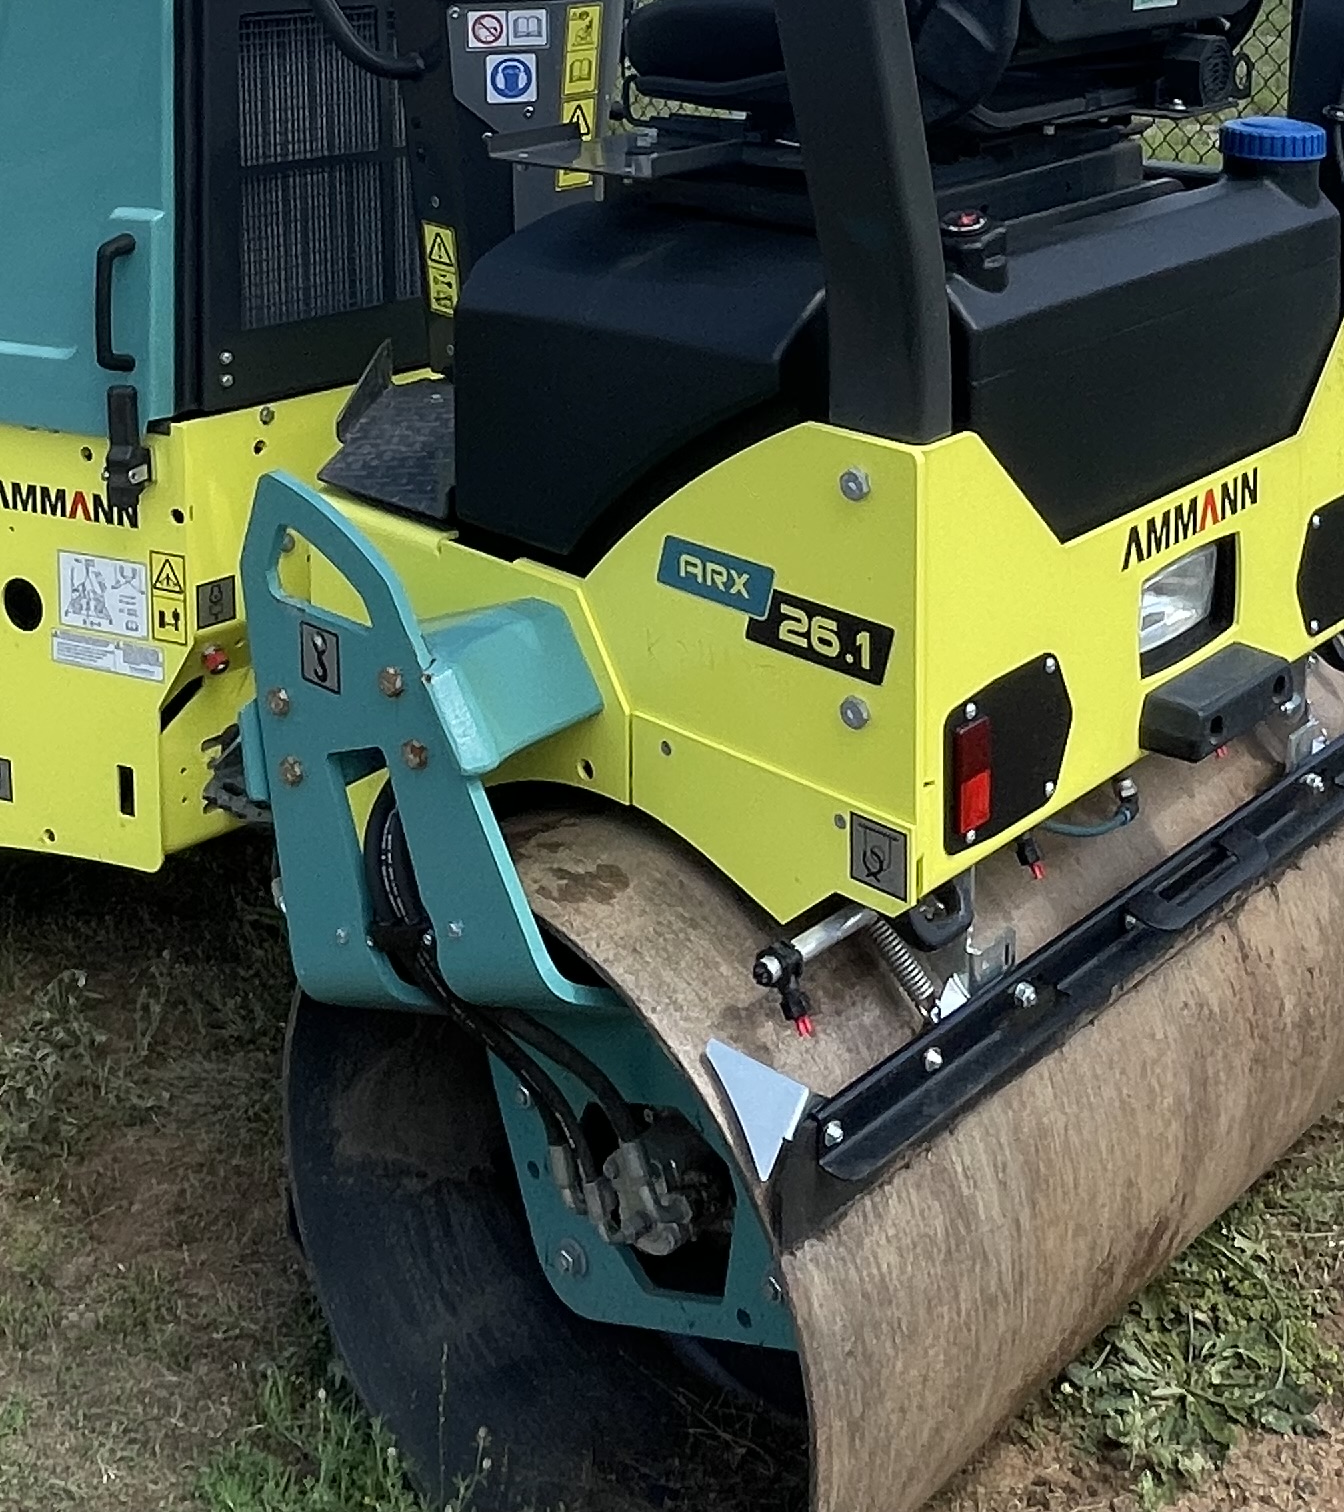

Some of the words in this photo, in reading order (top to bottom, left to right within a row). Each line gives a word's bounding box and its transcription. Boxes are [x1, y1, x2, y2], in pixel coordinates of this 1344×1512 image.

[1121, 466, 1258, 572] AMMANN
[678, 554, 749, 599] ARX
[778, 603, 870, 670] 26.1
